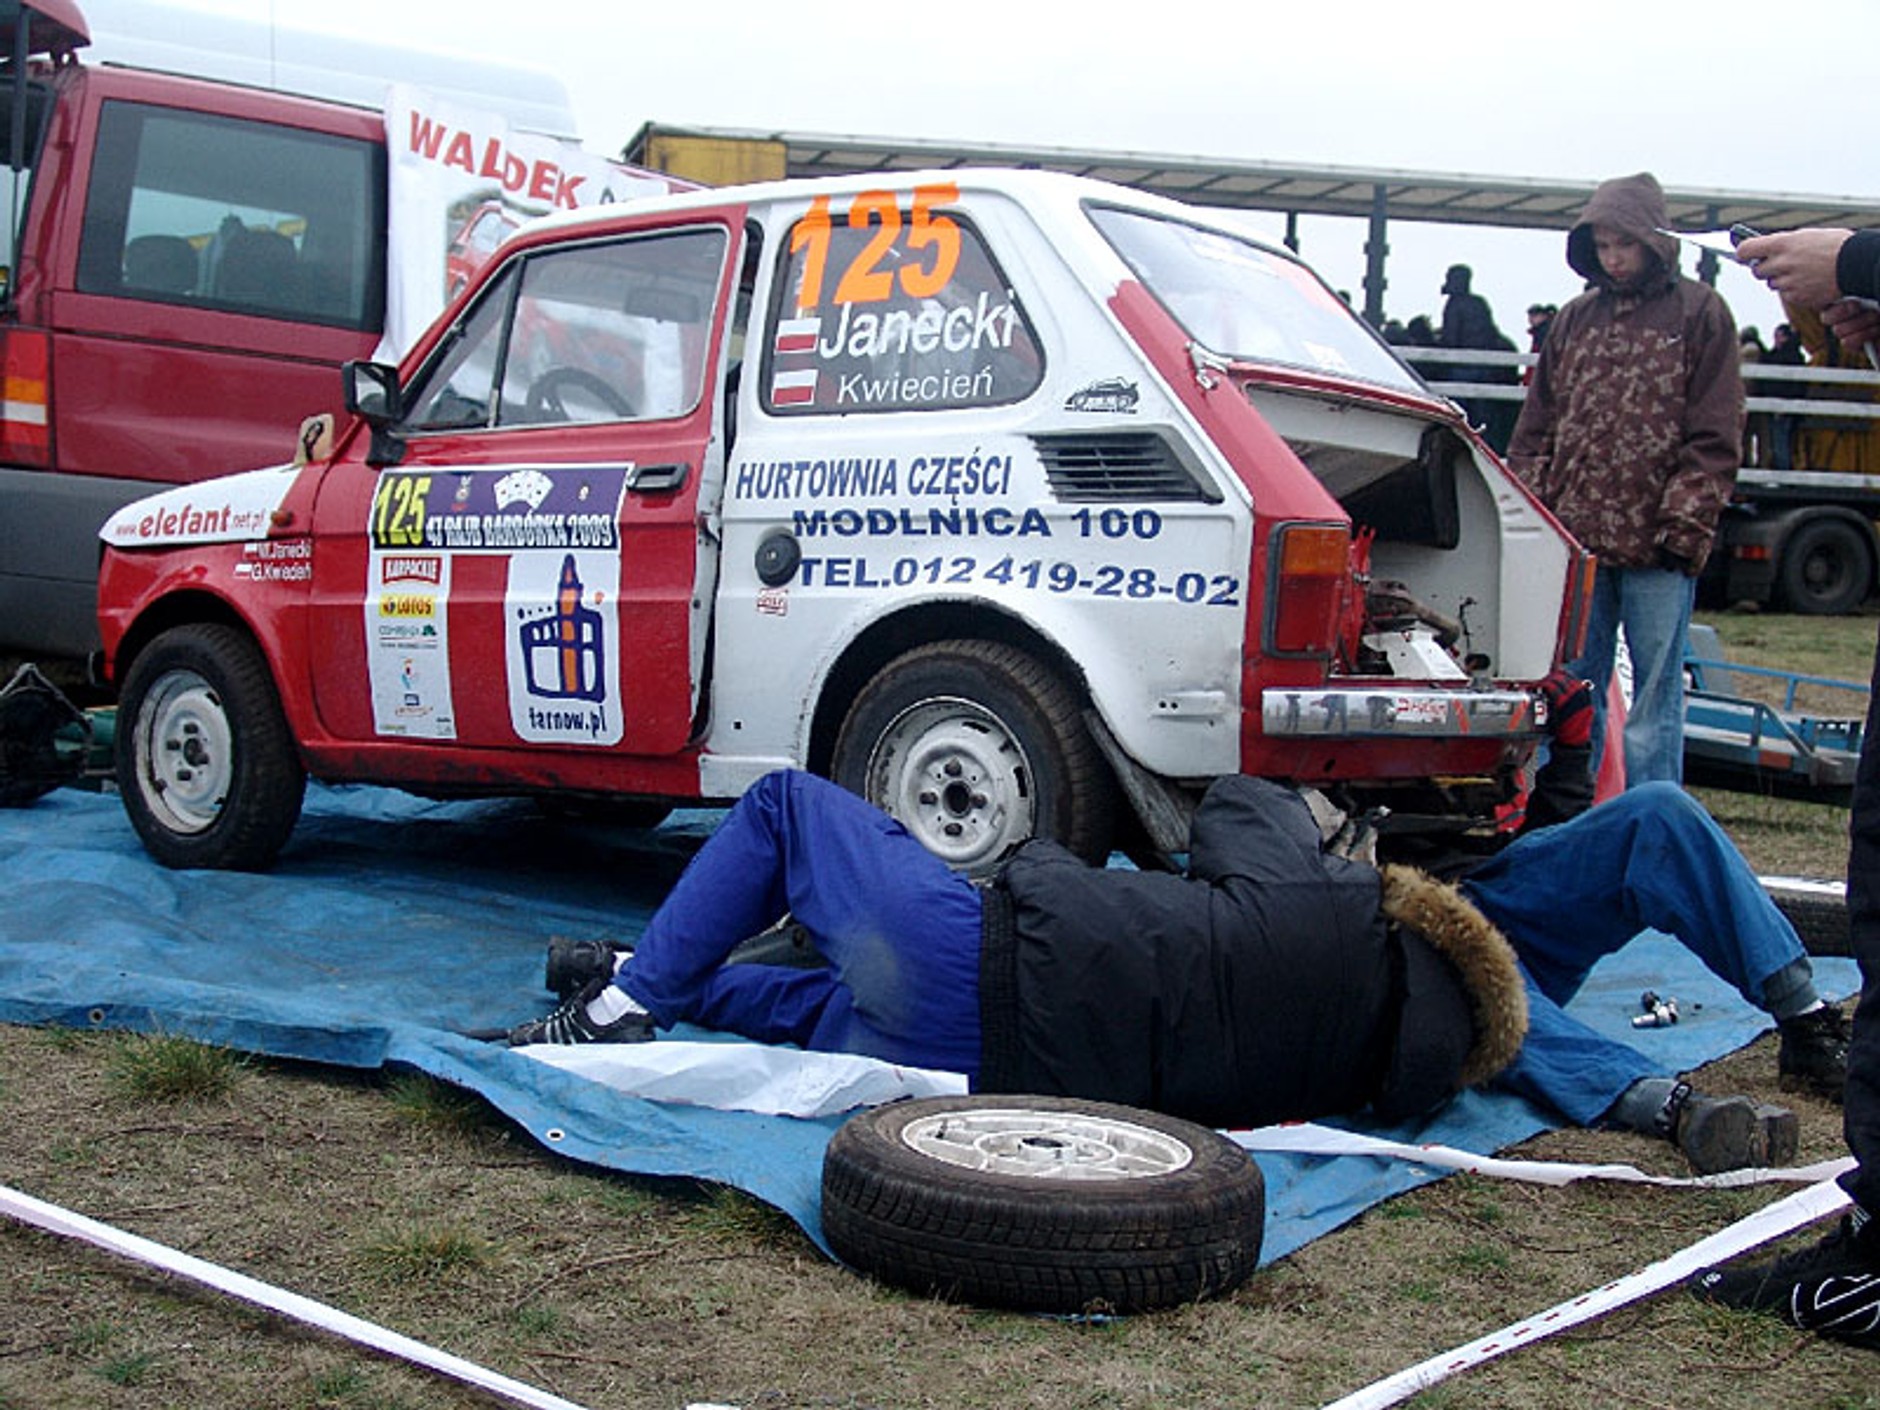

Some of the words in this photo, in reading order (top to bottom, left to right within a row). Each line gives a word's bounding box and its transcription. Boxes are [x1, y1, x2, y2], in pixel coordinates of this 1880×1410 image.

[408, 110, 587, 210] WALDEK
[790, 182, 962, 310] 125
[819, 289, 1015, 359] Janecki
[836, 365, 993, 404] Kwiecień
[735, 457, 898, 500] HURTOWNIA
[907, 445, 1012, 506] CZĘŚCI
[375, 476, 432, 546] 125
[568, 514, 613, 546] 2009
[792, 507, 1052, 538] MODLNICA
[1071, 507, 1163, 539] 100
[984, 553, 1239, 607] 419-28-02
[528, 705, 607, 739] tarnow.pl
